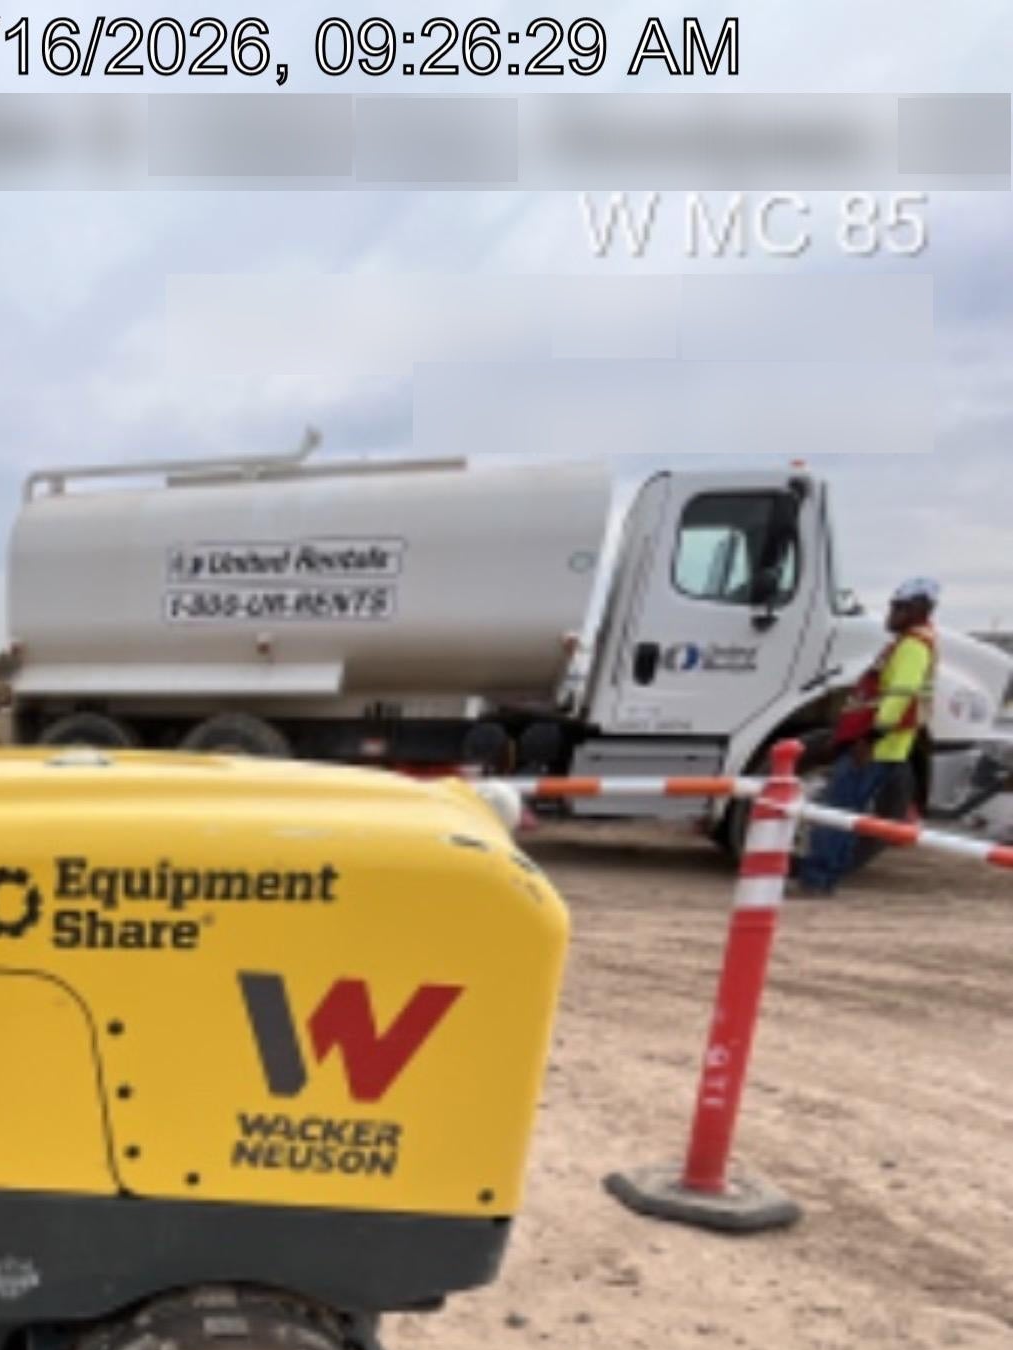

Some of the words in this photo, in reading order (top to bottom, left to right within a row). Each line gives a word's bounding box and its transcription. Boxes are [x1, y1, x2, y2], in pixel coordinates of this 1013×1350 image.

[54, 858, 338, 909] Equipment
[237, 1112, 401, 1148] WACKER
[231, 1141, 396, 1178] NEUSON
